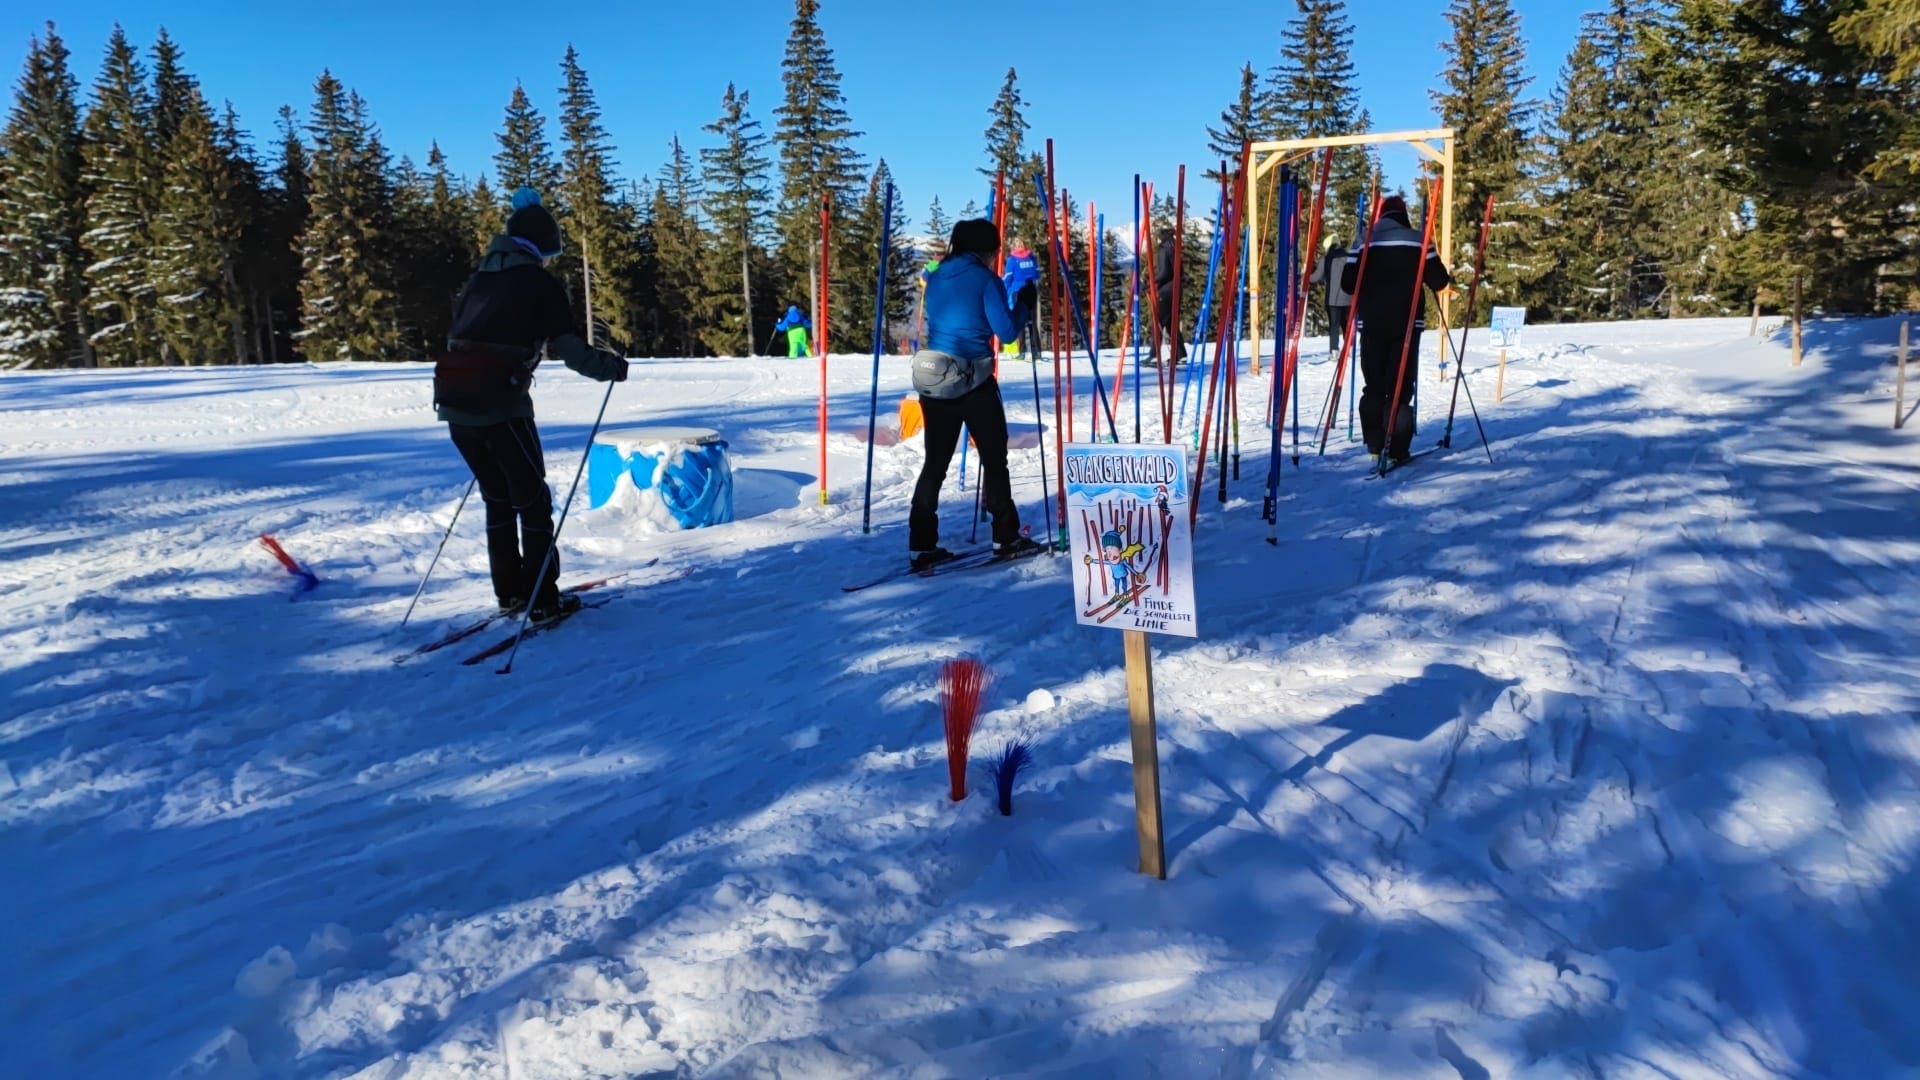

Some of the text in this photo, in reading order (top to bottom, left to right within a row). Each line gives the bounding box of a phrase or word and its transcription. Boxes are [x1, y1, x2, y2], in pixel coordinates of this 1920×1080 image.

[1067, 455, 1177, 484] STANGENWALD
[1144, 597, 1175, 611] FINDE
[1123, 608, 1191, 621] DIE SCHNELLSTE
[1135, 617, 1168, 630] LINIE
